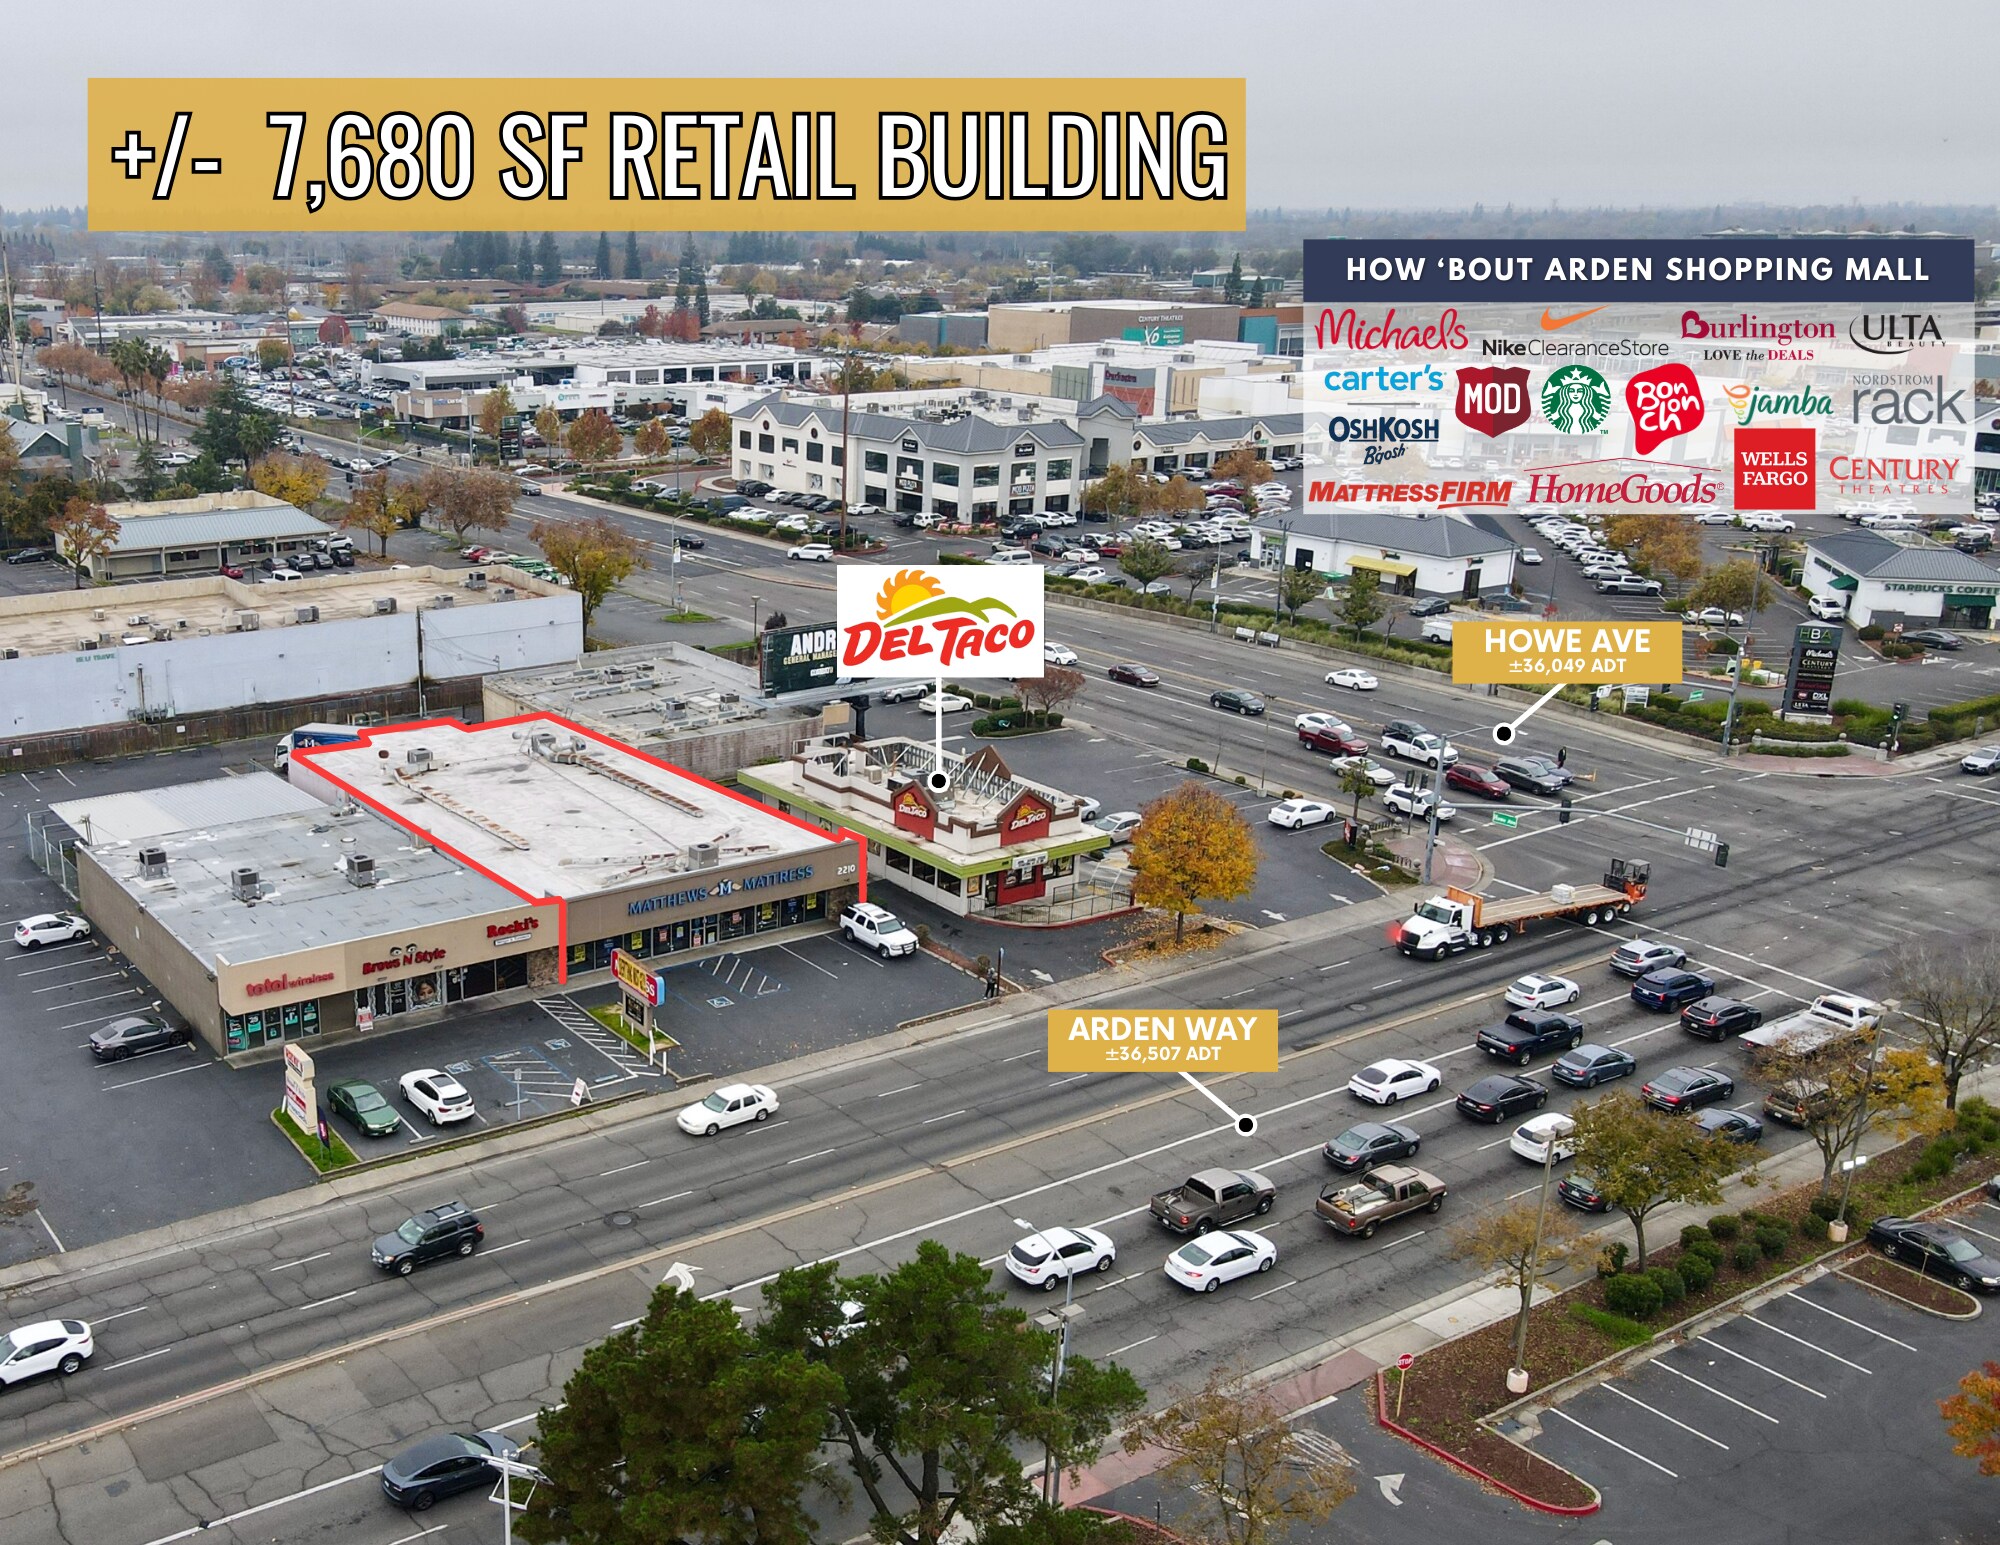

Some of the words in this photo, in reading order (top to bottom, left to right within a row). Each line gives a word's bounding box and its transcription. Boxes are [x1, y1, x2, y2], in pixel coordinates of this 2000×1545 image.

[1884, 584, 1954, 593] STARBUCKS
[783, 653, 810, 665] GENERAL
[837, 864, 856, 875] 2210
[628, 887, 707, 916] MATTHEWS
[743, 866, 814, 892] MATTRESS
[363, 957, 401, 975] Brows
[415, 948, 446, 966] Style
[246, 974, 288, 997] total
[288, 972, 334, 988] wireless
